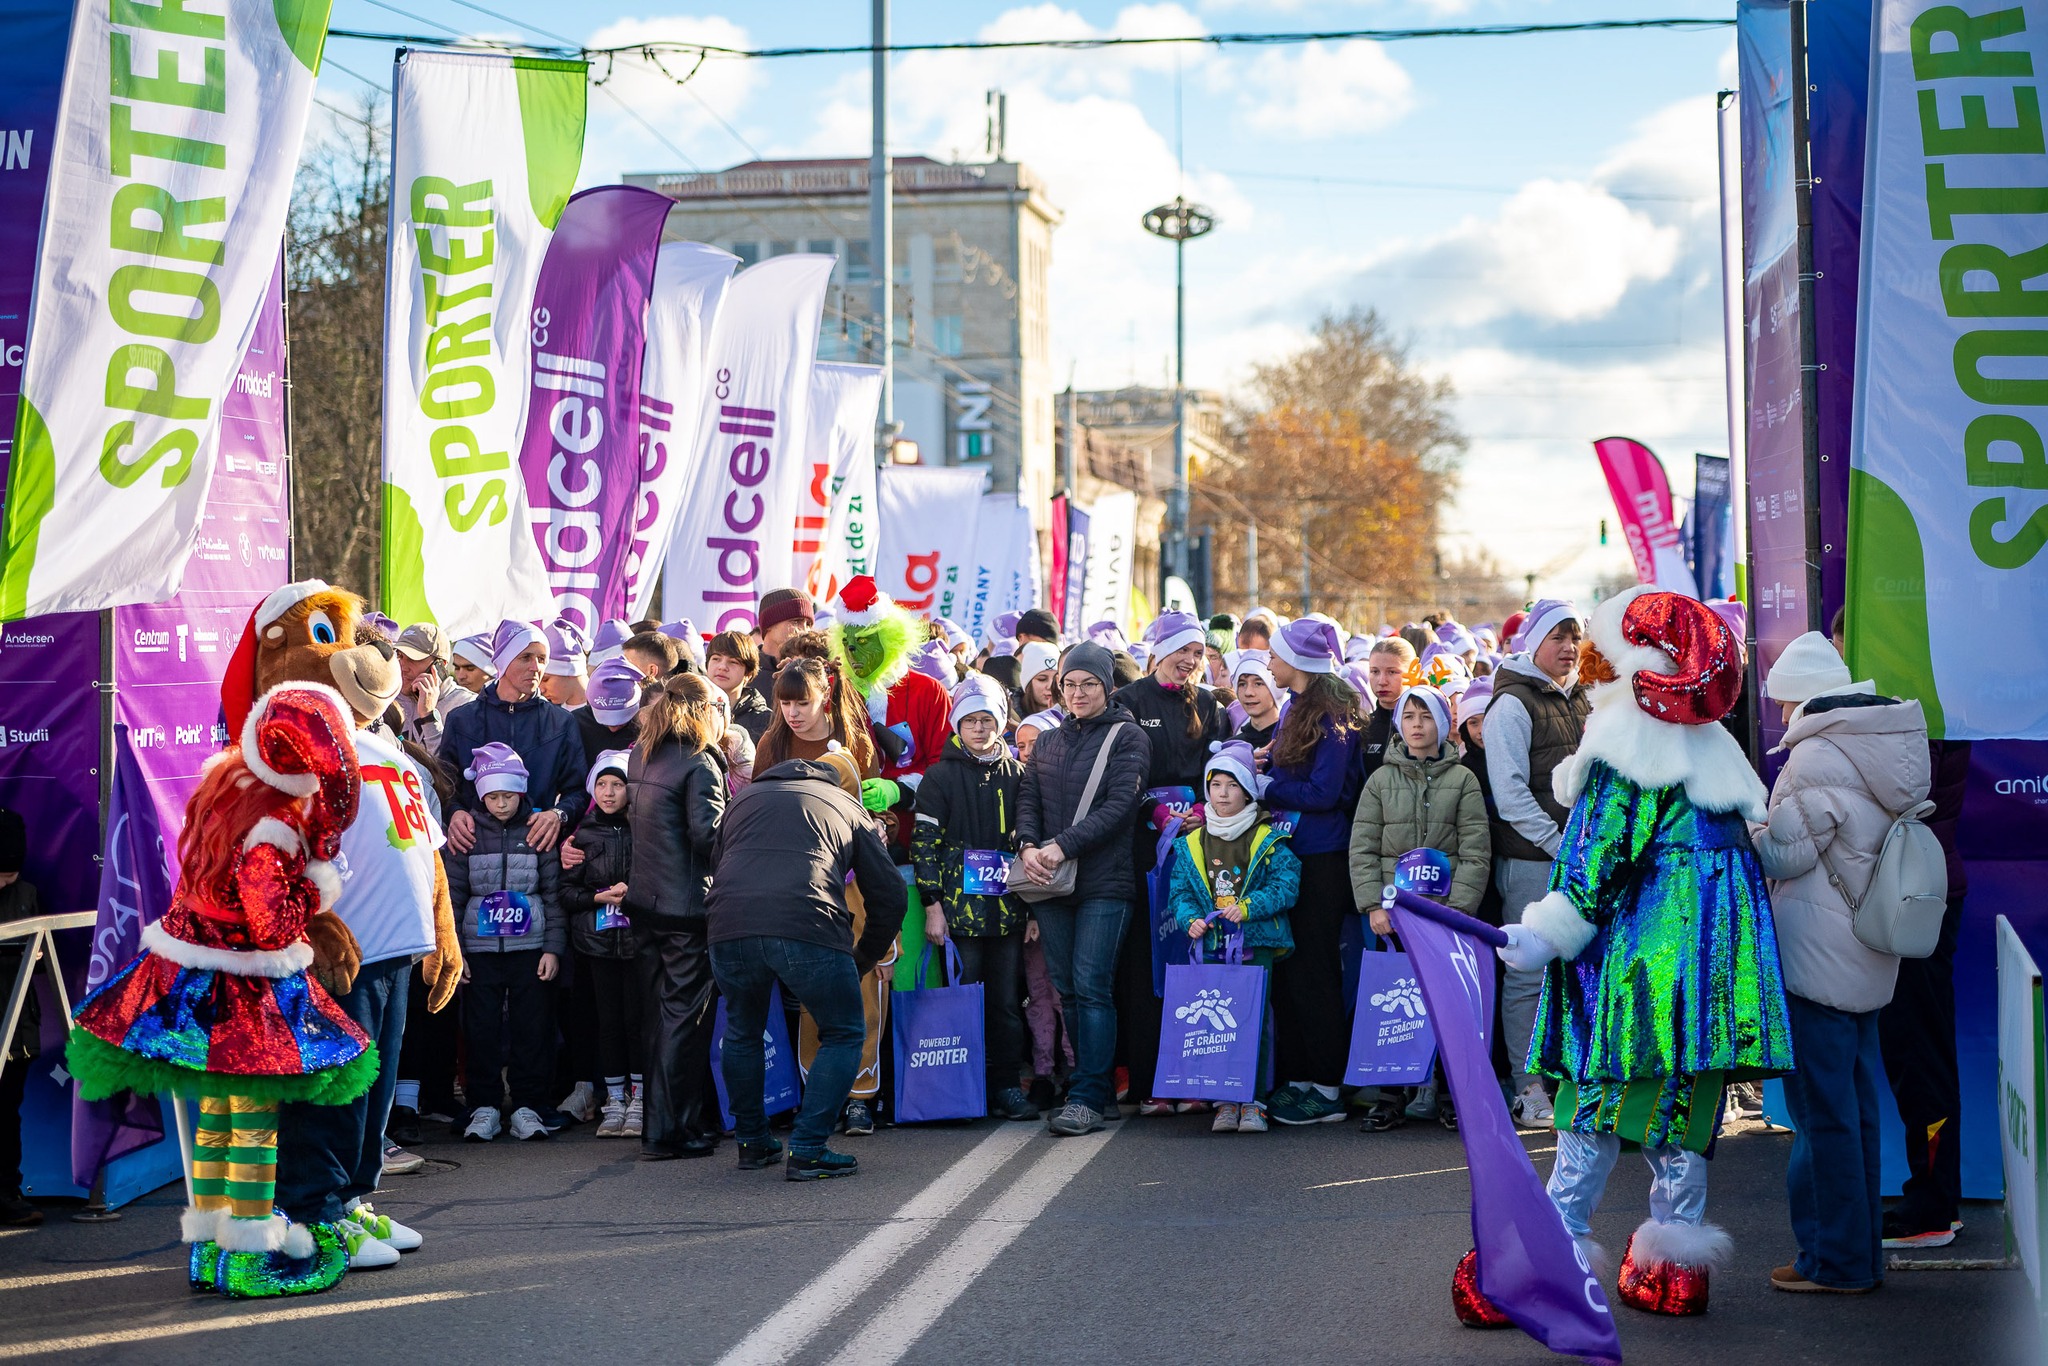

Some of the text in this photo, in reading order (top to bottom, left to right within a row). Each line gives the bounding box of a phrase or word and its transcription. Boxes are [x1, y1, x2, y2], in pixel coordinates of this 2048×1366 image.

[532, 306, 552, 348] CG
[411, 175, 510, 533] SPORTER
[237, 369, 272, 398] moldcell
[715, 368, 731, 399] CG
[845, 521, 863, 550] de
[5, 633, 54, 643] Andersen
[134, 628, 170, 645] Centrum
[10, 728, 49, 742] Studii
[134, 728, 155, 747] HIT
[1995, 775, 2048, 794] ami
[978, 866, 1010, 883] 1247
[1408, 865, 1440, 881] 1155
[489, 907, 523, 923] 1428
[1379, 1019, 1425, 1037] DE CRĂCIUN
[918, 1036, 961, 1048] POWERED BY
[1183, 1032, 1237, 1049] DE CRĂCIUN
[1377, 1032, 1414, 1046] BY MOLDCELL
[910, 1048, 968, 1068] SPORTER
[1182, 1045, 1227, 1058] BY MOLDCELL
